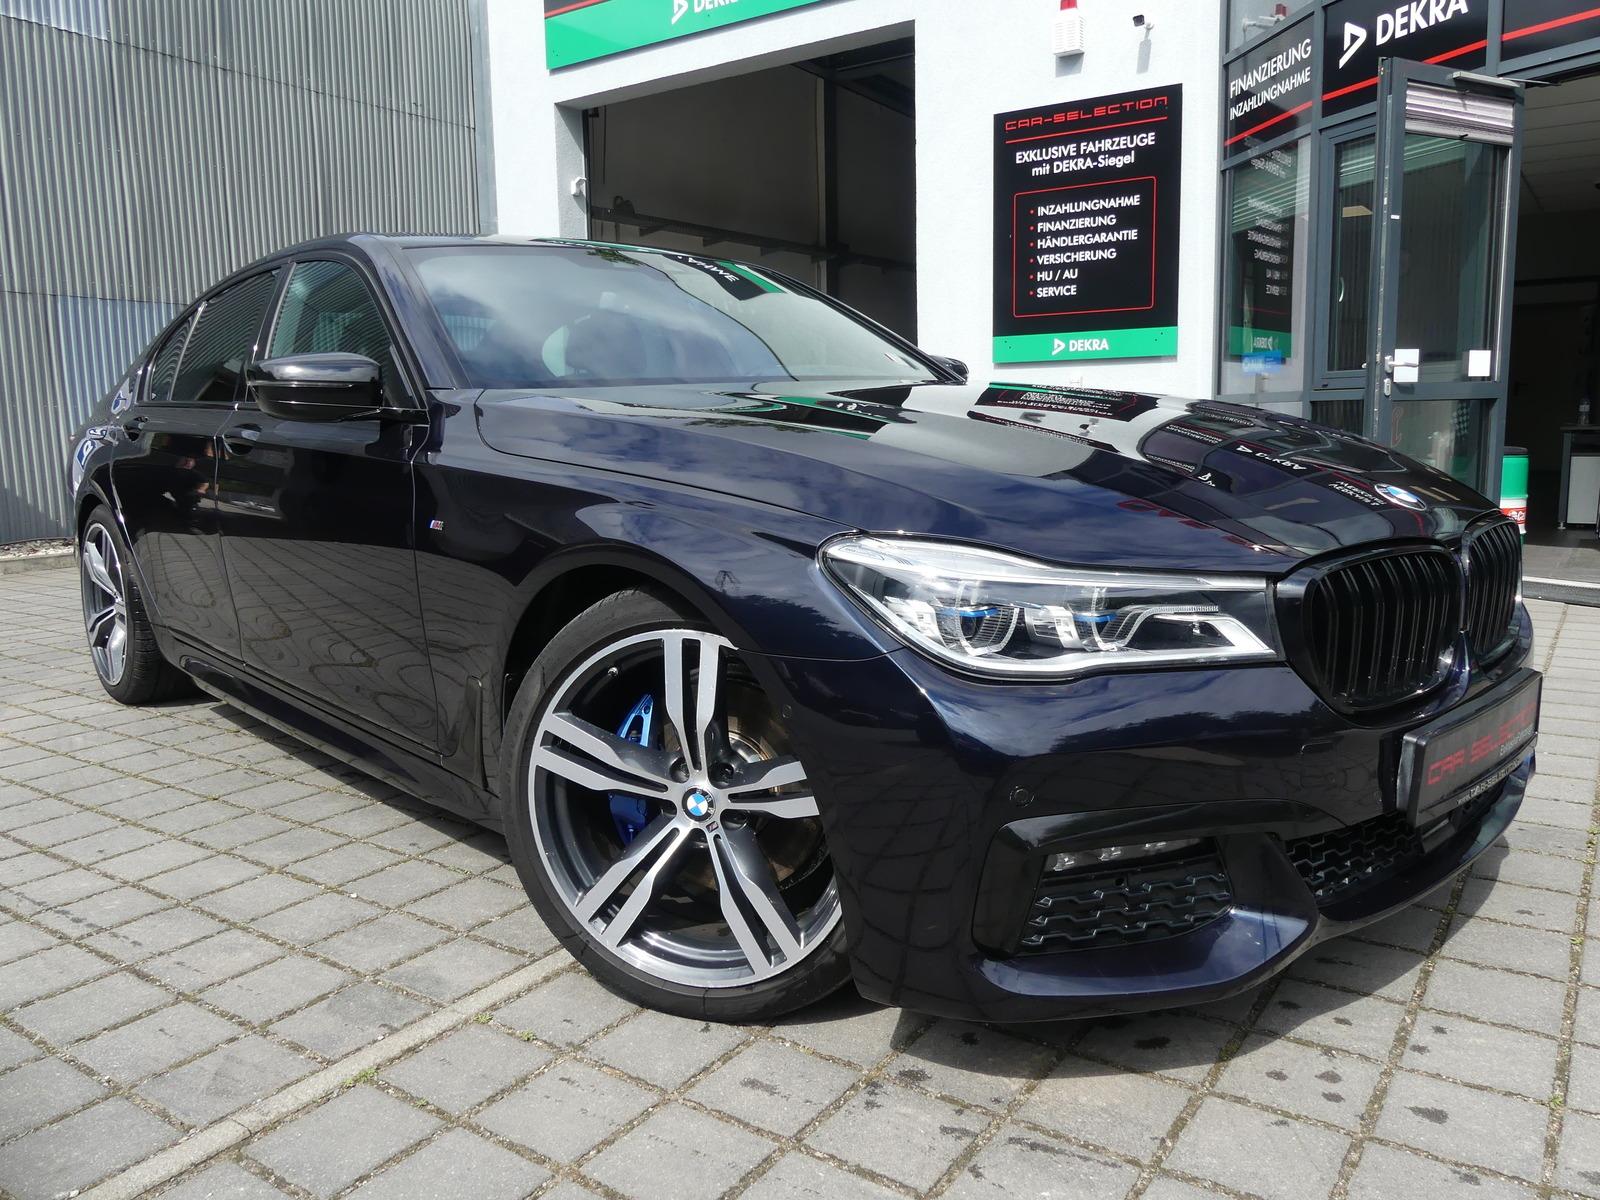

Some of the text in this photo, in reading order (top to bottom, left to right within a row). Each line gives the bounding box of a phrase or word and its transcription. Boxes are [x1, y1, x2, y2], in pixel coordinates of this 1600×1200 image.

[1375, 0, 1469, 46] DEKRA
[1229, 38, 1312, 99] FINANZIERUNG
[1229, 66, 1312, 121] INZAHLUNGNAHME
[1005, 95, 1168, 133] CAR-SELECTION
[1015, 132, 1156, 165] EXKLUSIVE FAHRZEUGE
[1031, 150, 1135, 177] mit DEKRA-Siegel
[1037, 194, 1141, 217] INZAHLUNGNAHME
[1037, 214, 1117, 233] FINANZIERUNG
[1037, 229, 1138, 249] HÄNDLERGARANTIE
[1037, 249, 1117, 266] VERSICHERUNG
[1036, 272, 1053, 282] HU
[1062, 268, 1079, 280] AU
[1036, 285, 1077, 298] SERVICE
[1069, 338, 1110, 352] DEKRA
